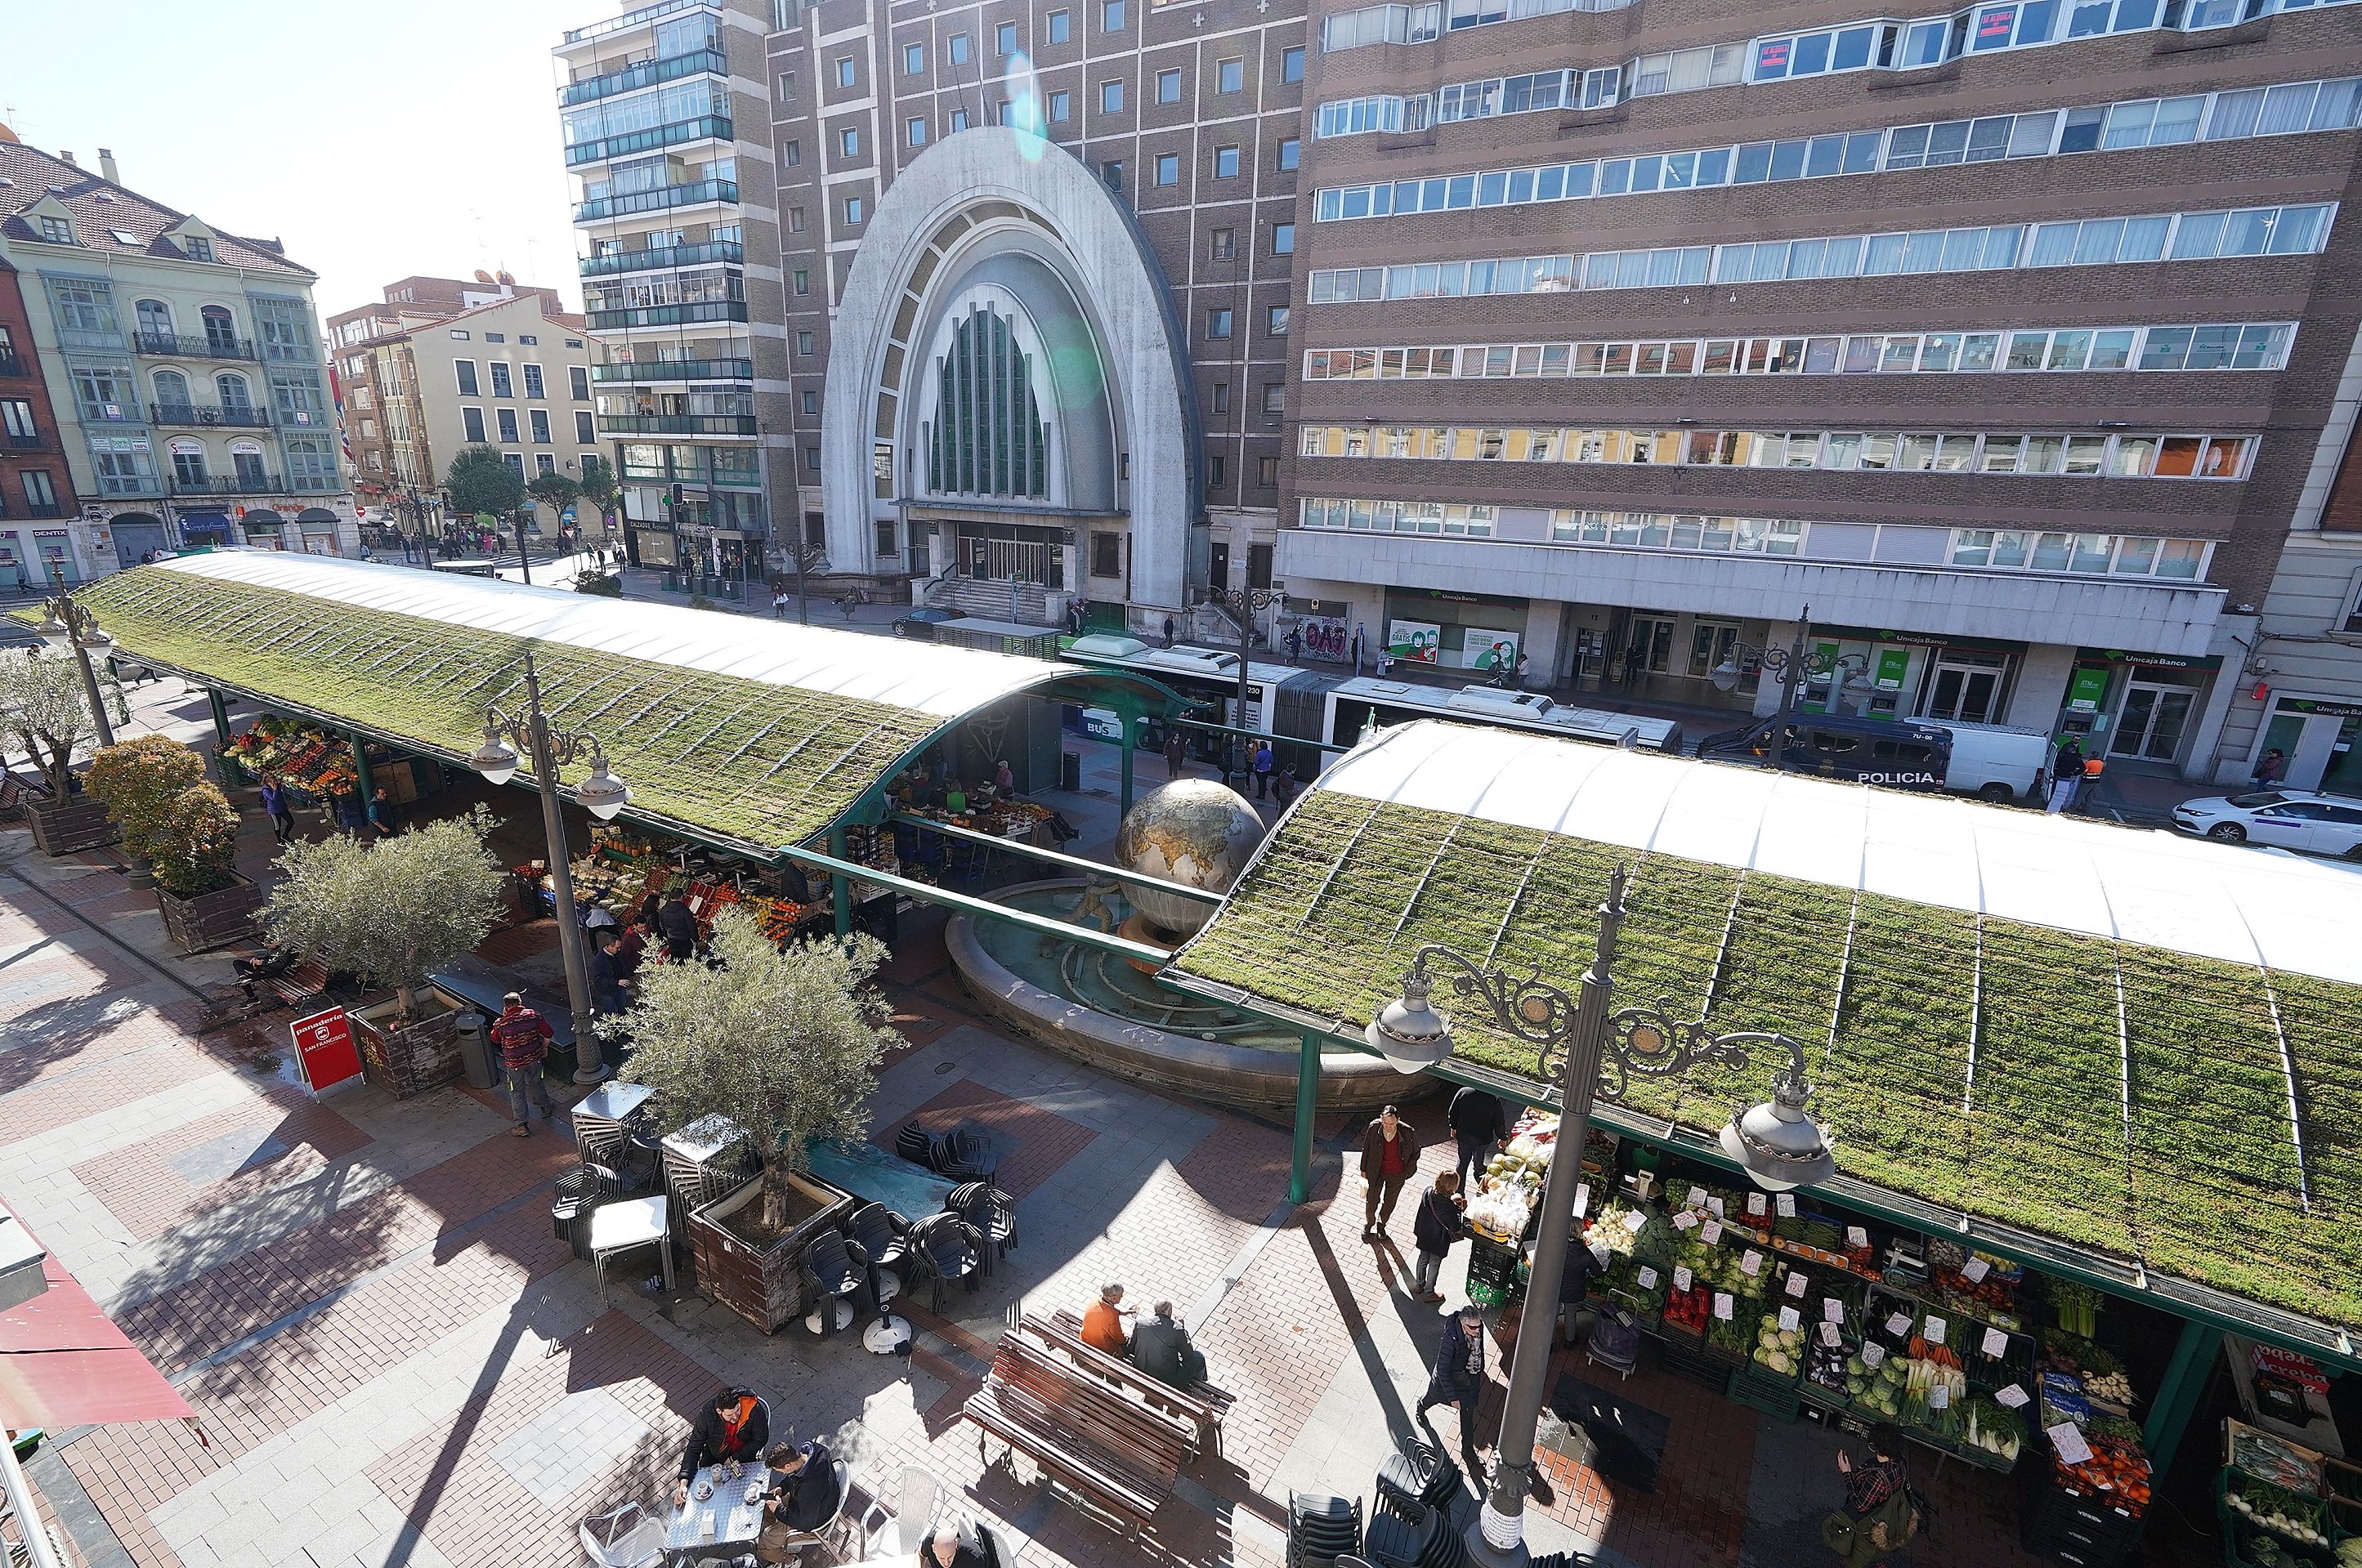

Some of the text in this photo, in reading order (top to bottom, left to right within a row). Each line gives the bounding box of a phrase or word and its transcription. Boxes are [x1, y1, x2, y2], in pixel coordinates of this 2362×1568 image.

[272, 503, 305, 512] Orange
[1393, 633, 1411, 642] GRATIS
[1896, 635, 1948, 646] Unicaja Banco
[2125, 655, 2186, 667] Unicaja Banco
[1247, 686, 1260, 695] 230
[2316, 705, 2350, 715] Unicaja
[1087, 722, 1109, 735] BUS
[1858, 772, 1935, 784] POLICIA
[296, 1013, 343, 1036] panadería
[304, 1033, 347, 1053] SAN FRANCISCO
